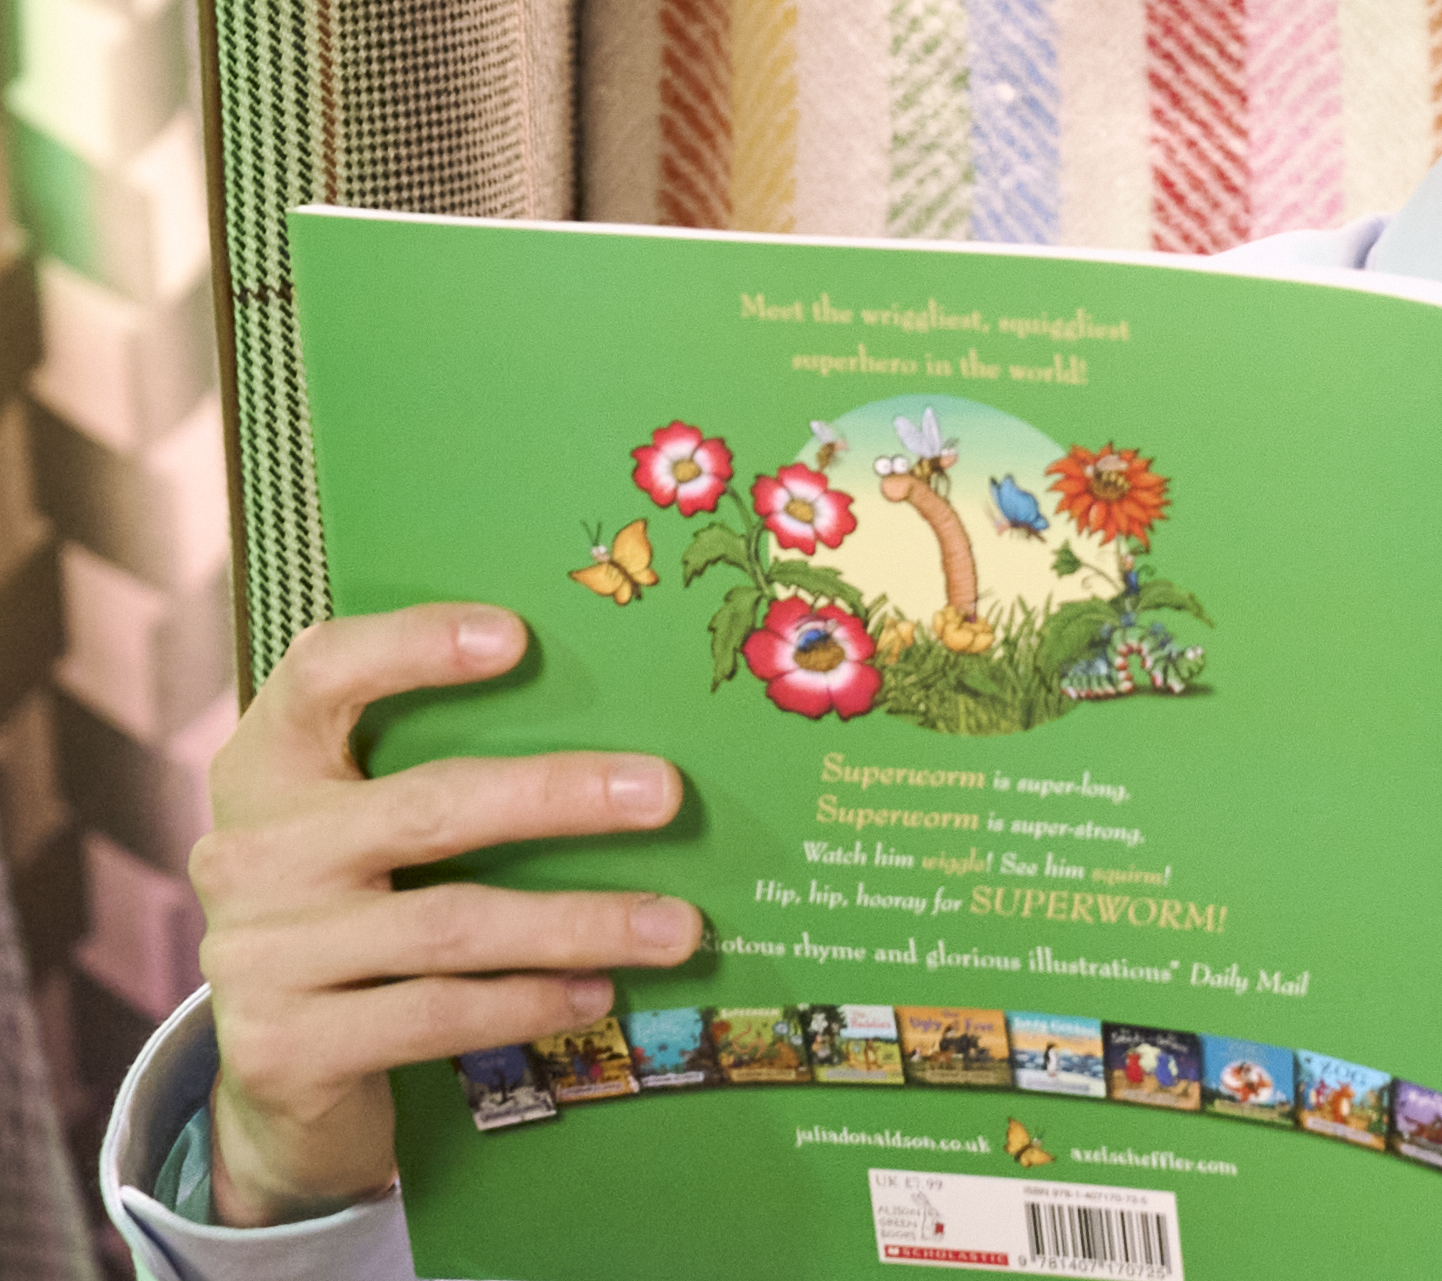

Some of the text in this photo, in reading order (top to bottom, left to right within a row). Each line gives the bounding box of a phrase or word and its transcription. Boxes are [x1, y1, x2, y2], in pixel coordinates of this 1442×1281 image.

[740, 291, 1131, 341] Meet the wriggliest, squiggliest
[791, 342, 1089, 385] superhero in the world!
[821, 751, 1132, 805] Superworm is super-long.
[816, 793, 1146, 848] Superworm is super-strong.
[803, 840, 1172, 888] Watch him wiggle! See him squirm!
[754, 879, 1229, 934] Hip, hip, hooray for SUPERWORM!
[793, 931, 866, 964] rhyme
[874, 937, 918, 964] and
[925, 939, 1021, 972] glorious
[1189, 961, 1249, 996] Daily
[1255, 967, 1311, 998] Mail
[794, 1124, 1239, 1177] juliadonaldson.co.uk axelscheffler.com
[875, 1174, 898, 1188] UK
[902, 1247, 1008, 1265] SCHOLASTIC
